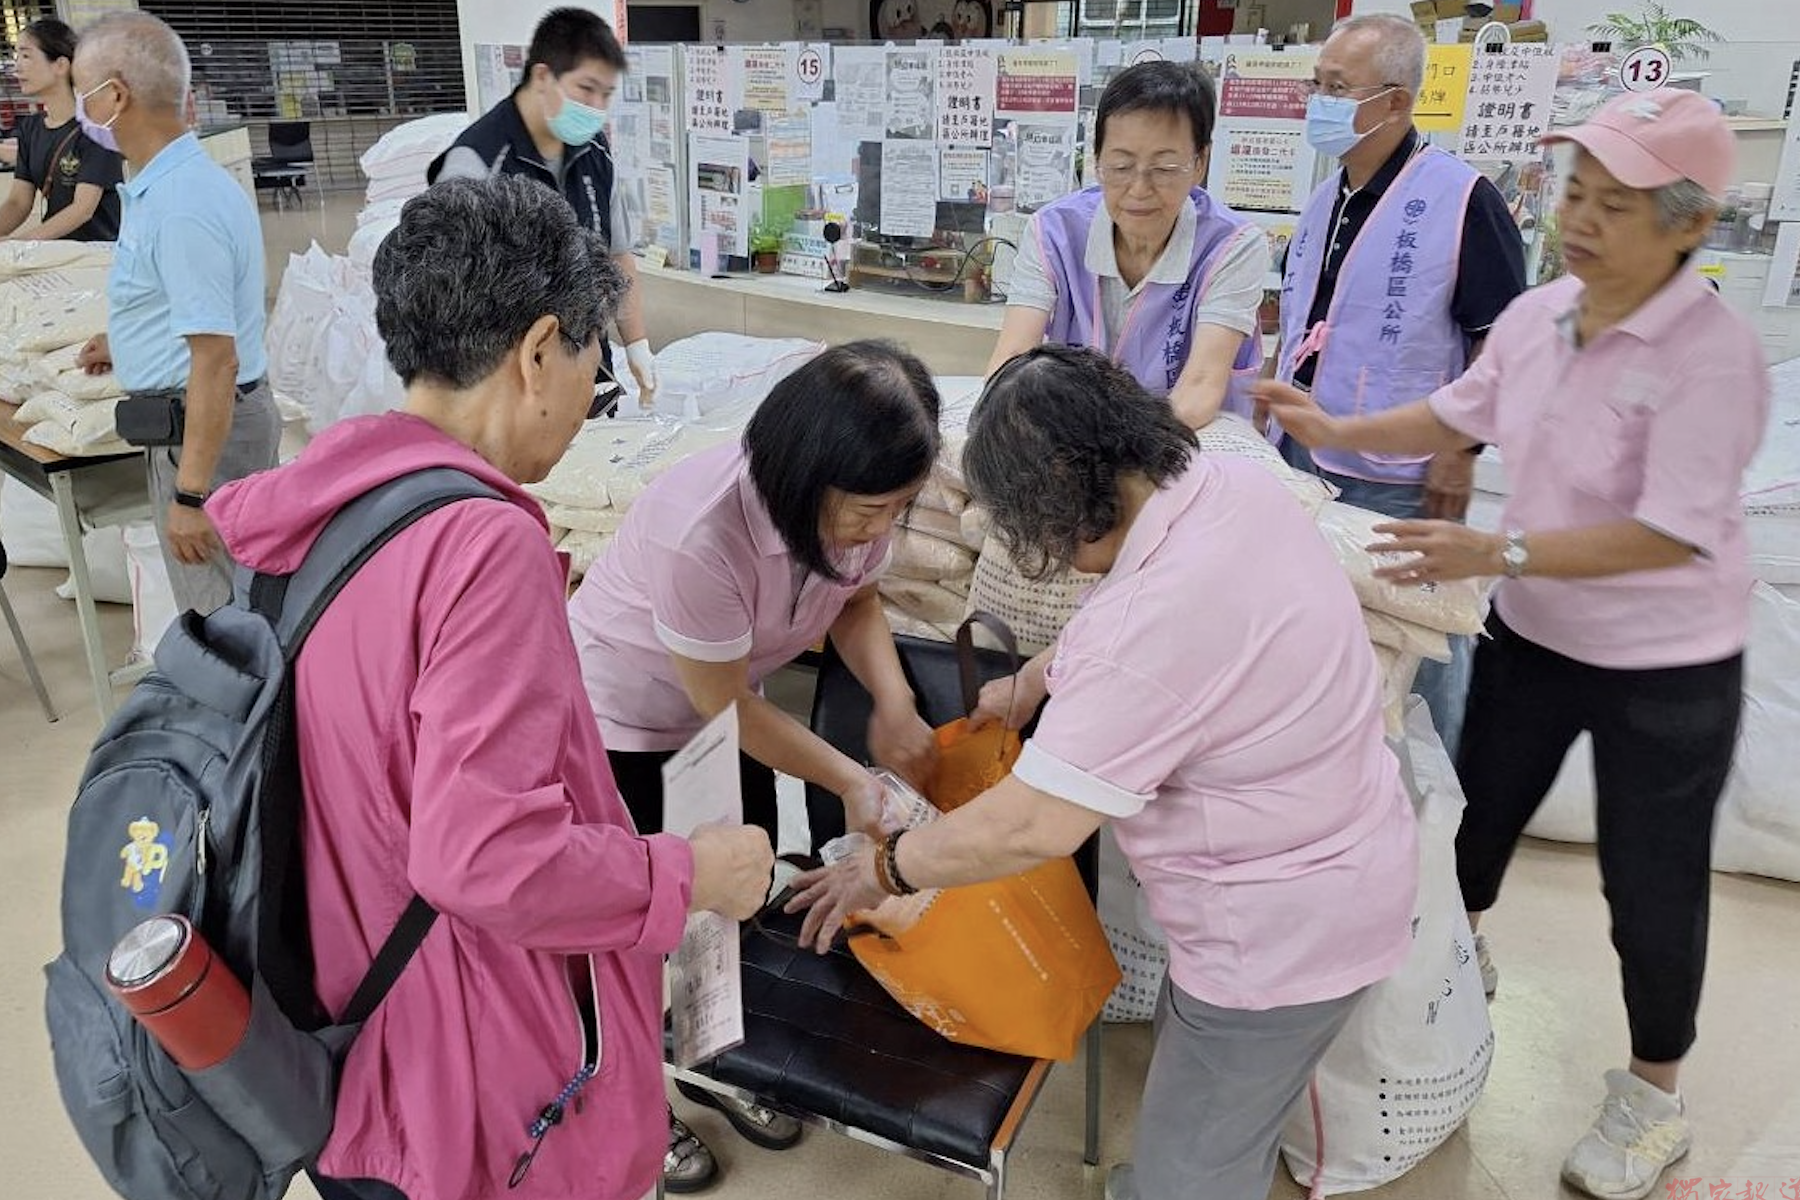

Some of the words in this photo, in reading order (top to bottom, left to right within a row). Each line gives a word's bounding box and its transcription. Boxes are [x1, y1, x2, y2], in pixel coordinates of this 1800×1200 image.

[800, 58, 819, 76] 15
[1628, 60, 1662, 82] 13
[1477, 101, 1536, 119] 證明書
[1378, 229, 1418, 345] 板橋區公所
